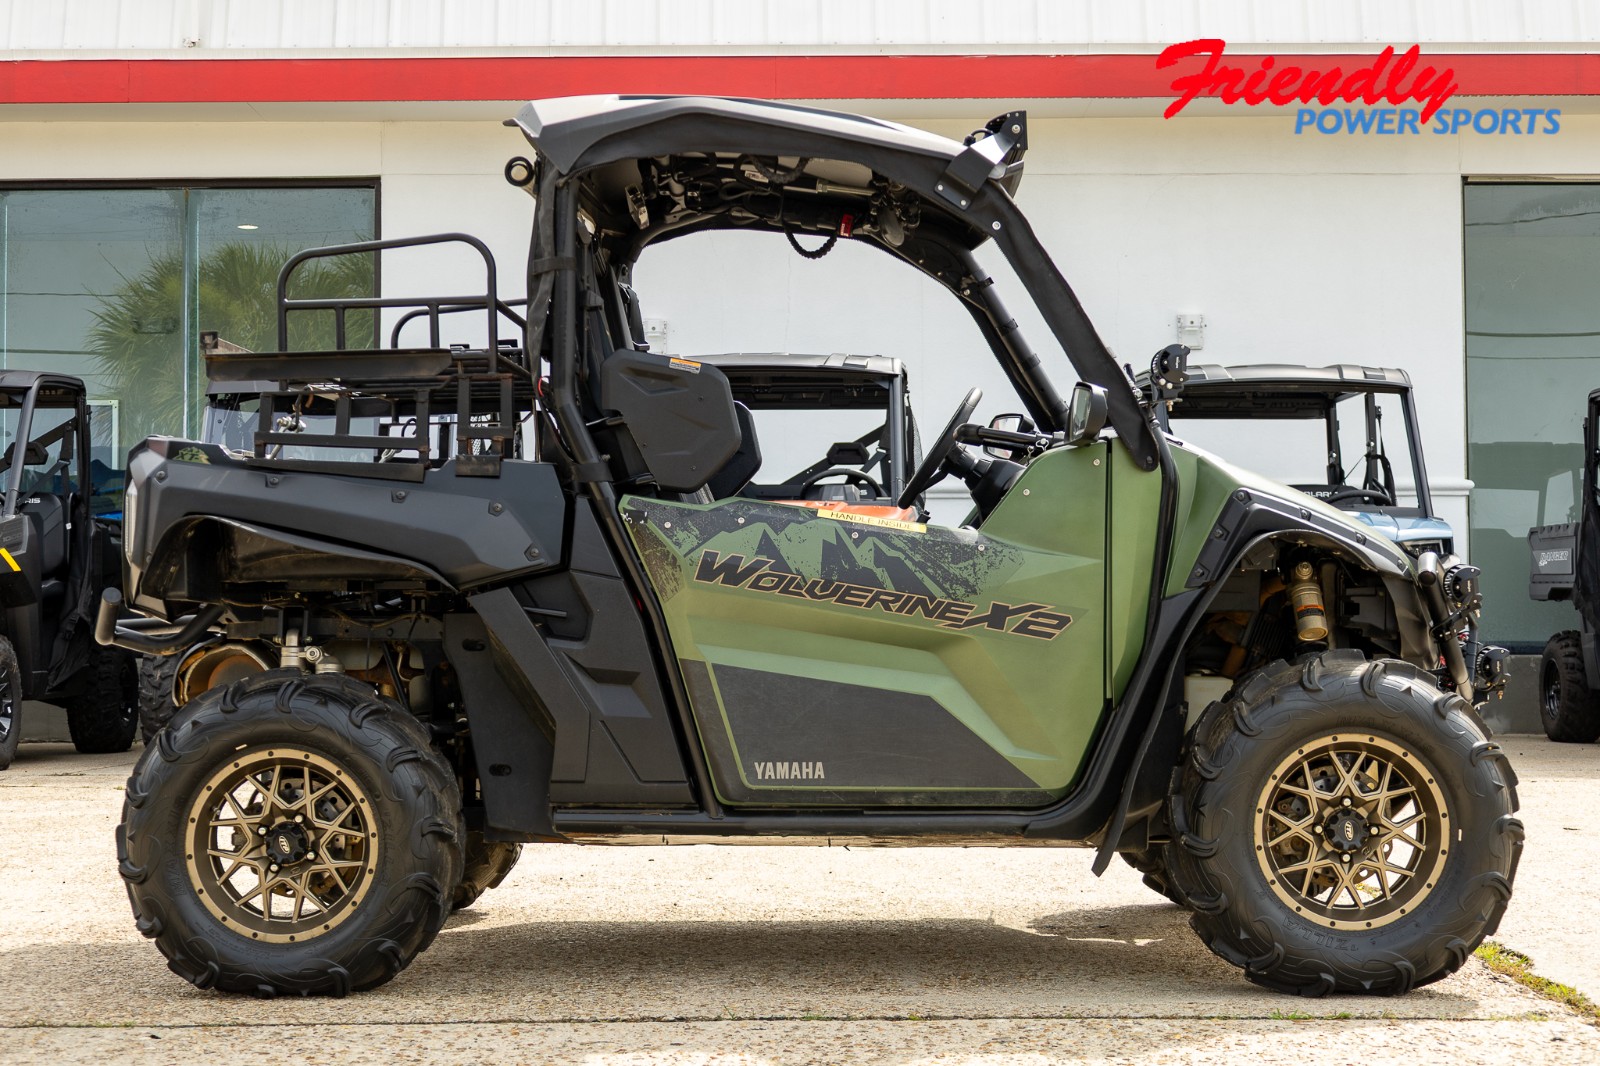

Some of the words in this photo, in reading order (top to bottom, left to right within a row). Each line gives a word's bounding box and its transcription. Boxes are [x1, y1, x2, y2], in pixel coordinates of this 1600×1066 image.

[830, 511, 872, 525] HANDLE
[878, 518, 912, 530] INSIDE
[694, 549, 978, 626] WOLVERINE
[938, 601, 1073, 641] X2
[754, 761, 825, 779] YAMAHA
